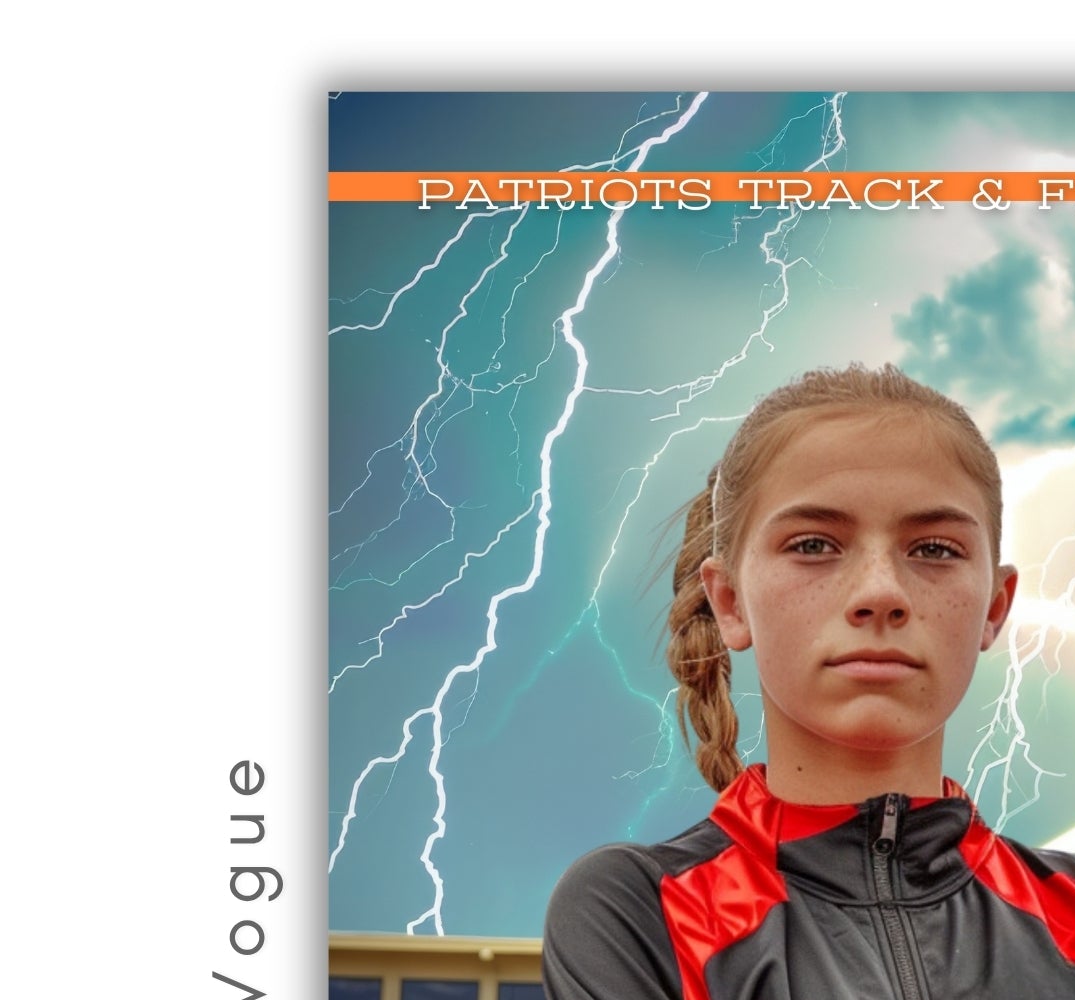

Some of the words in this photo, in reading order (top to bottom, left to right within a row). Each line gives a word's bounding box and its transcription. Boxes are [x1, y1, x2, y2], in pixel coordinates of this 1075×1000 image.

[418, 178, 713, 211] PATRIOTS
[737, 178, 945, 211] TRACK
[971, 178, 1011, 211] &
